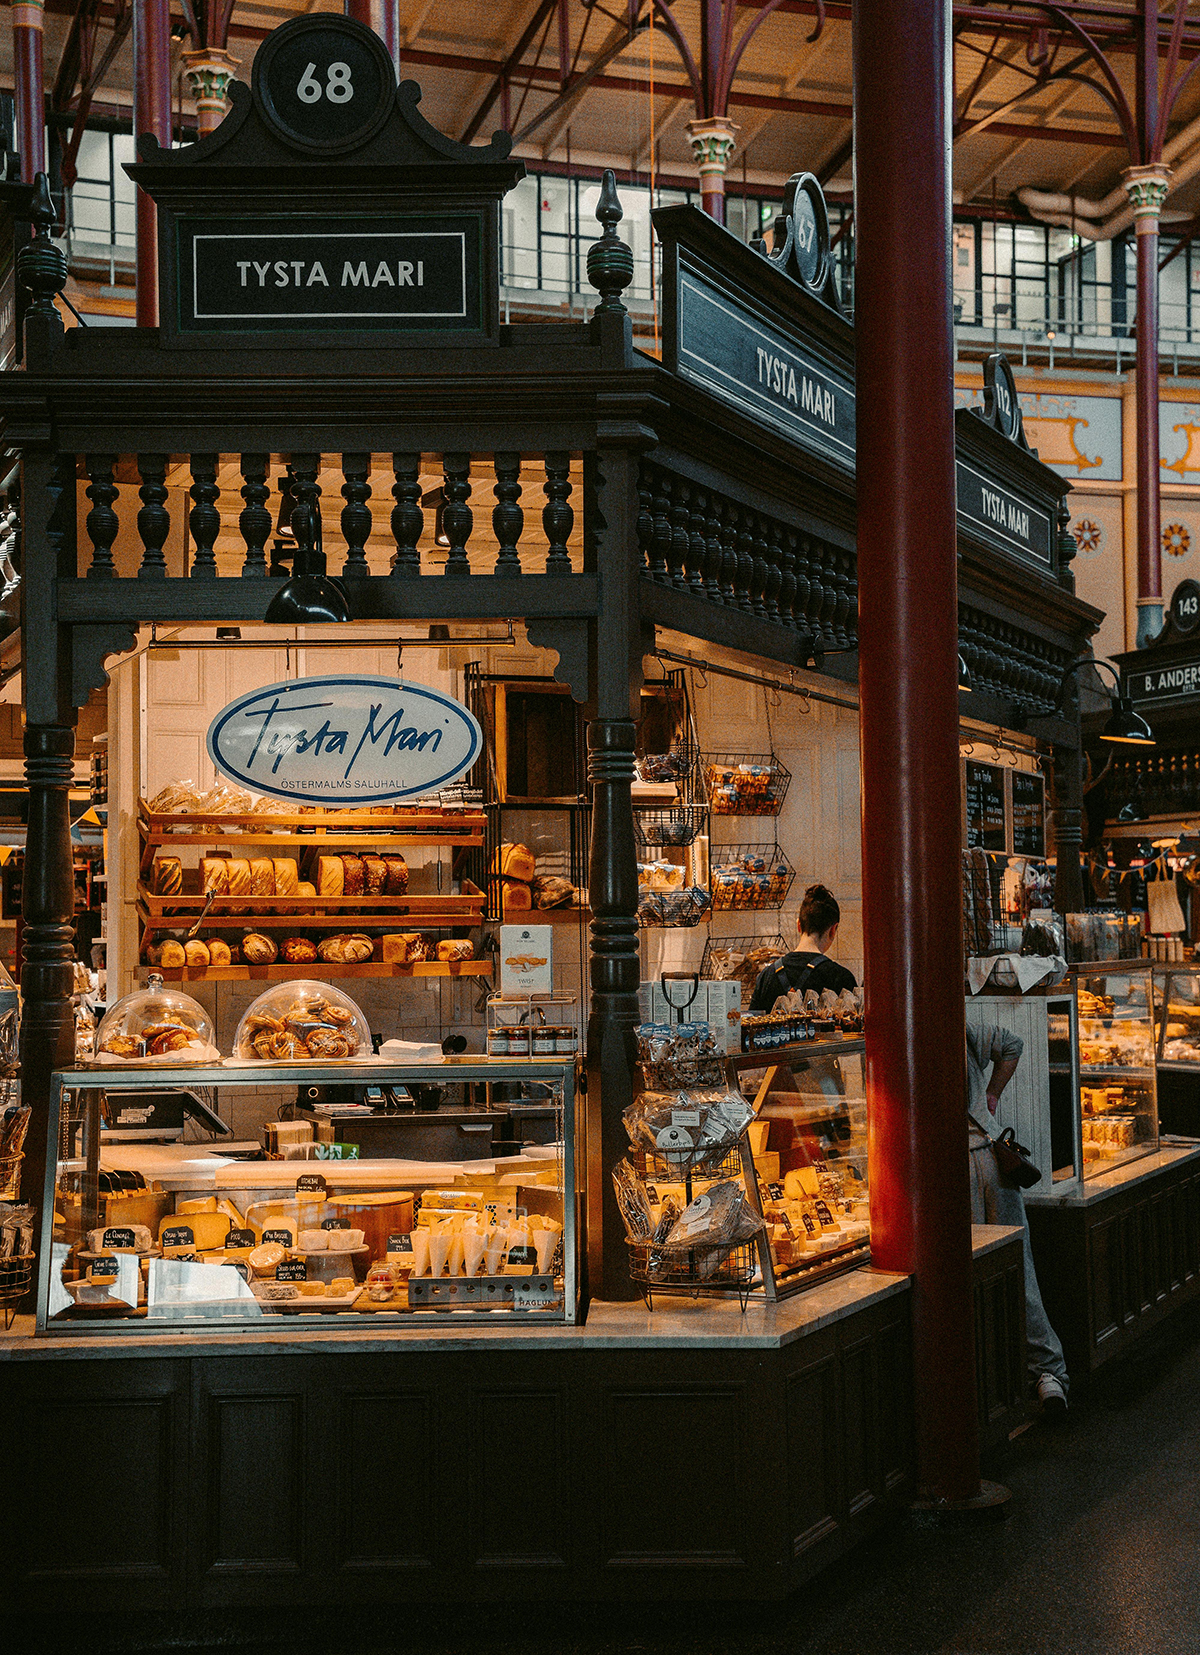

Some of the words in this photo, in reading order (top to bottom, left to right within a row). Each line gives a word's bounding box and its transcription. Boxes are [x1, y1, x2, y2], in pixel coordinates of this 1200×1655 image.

[296, 62, 354, 104] 68
[798, 221, 816, 254] 67
[236, 261, 330, 287] TYSTA
[340, 261, 424, 287] MARI
[756, 346, 798, 405] TYSTA
[801, 375, 836, 427] MARI
[995, 382, 1012, 417] 112
[981, 487, 1008, 527] TYSTA
[1007, 503, 1030, 541] MARI
[1178, 596, 1199, 616] 143
[1144, 675, 1156, 691] B.
[245, 697, 349, 774] Tysta
[344, 703, 450, 779] Mari
[280, 778, 352, 789] ÖSTERMALMS
[354, 779, 408, 789] SALUHALL
